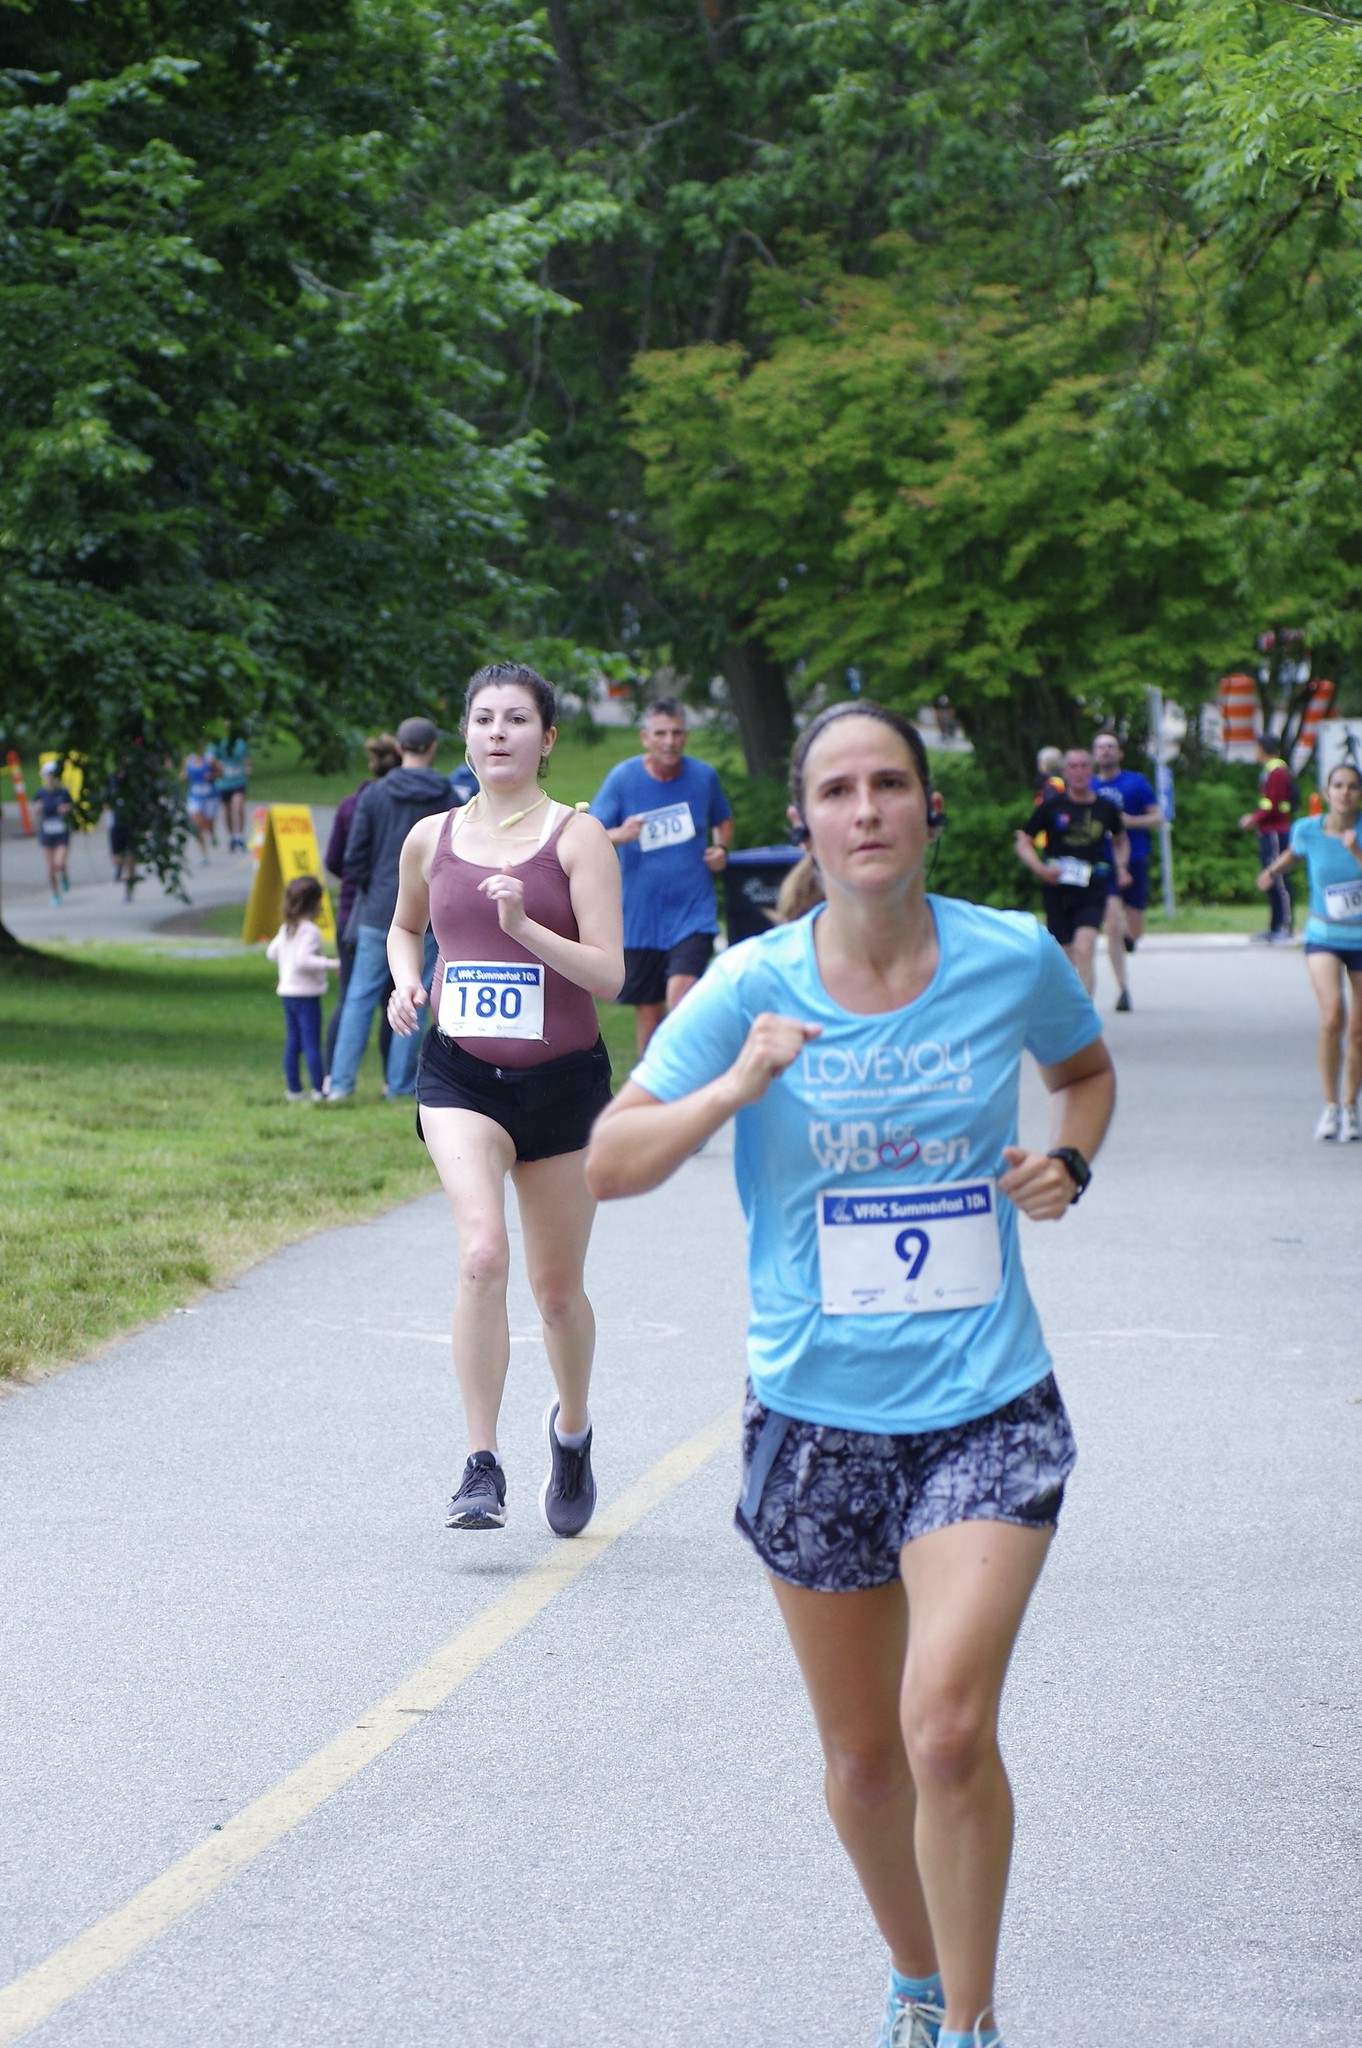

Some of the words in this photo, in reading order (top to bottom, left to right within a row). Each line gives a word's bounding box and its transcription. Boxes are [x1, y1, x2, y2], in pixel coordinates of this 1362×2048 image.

[458, 986, 522, 1019] 180
[808, 1119, 877, 1150] run
[895, 1227, 930, 1282] 9
